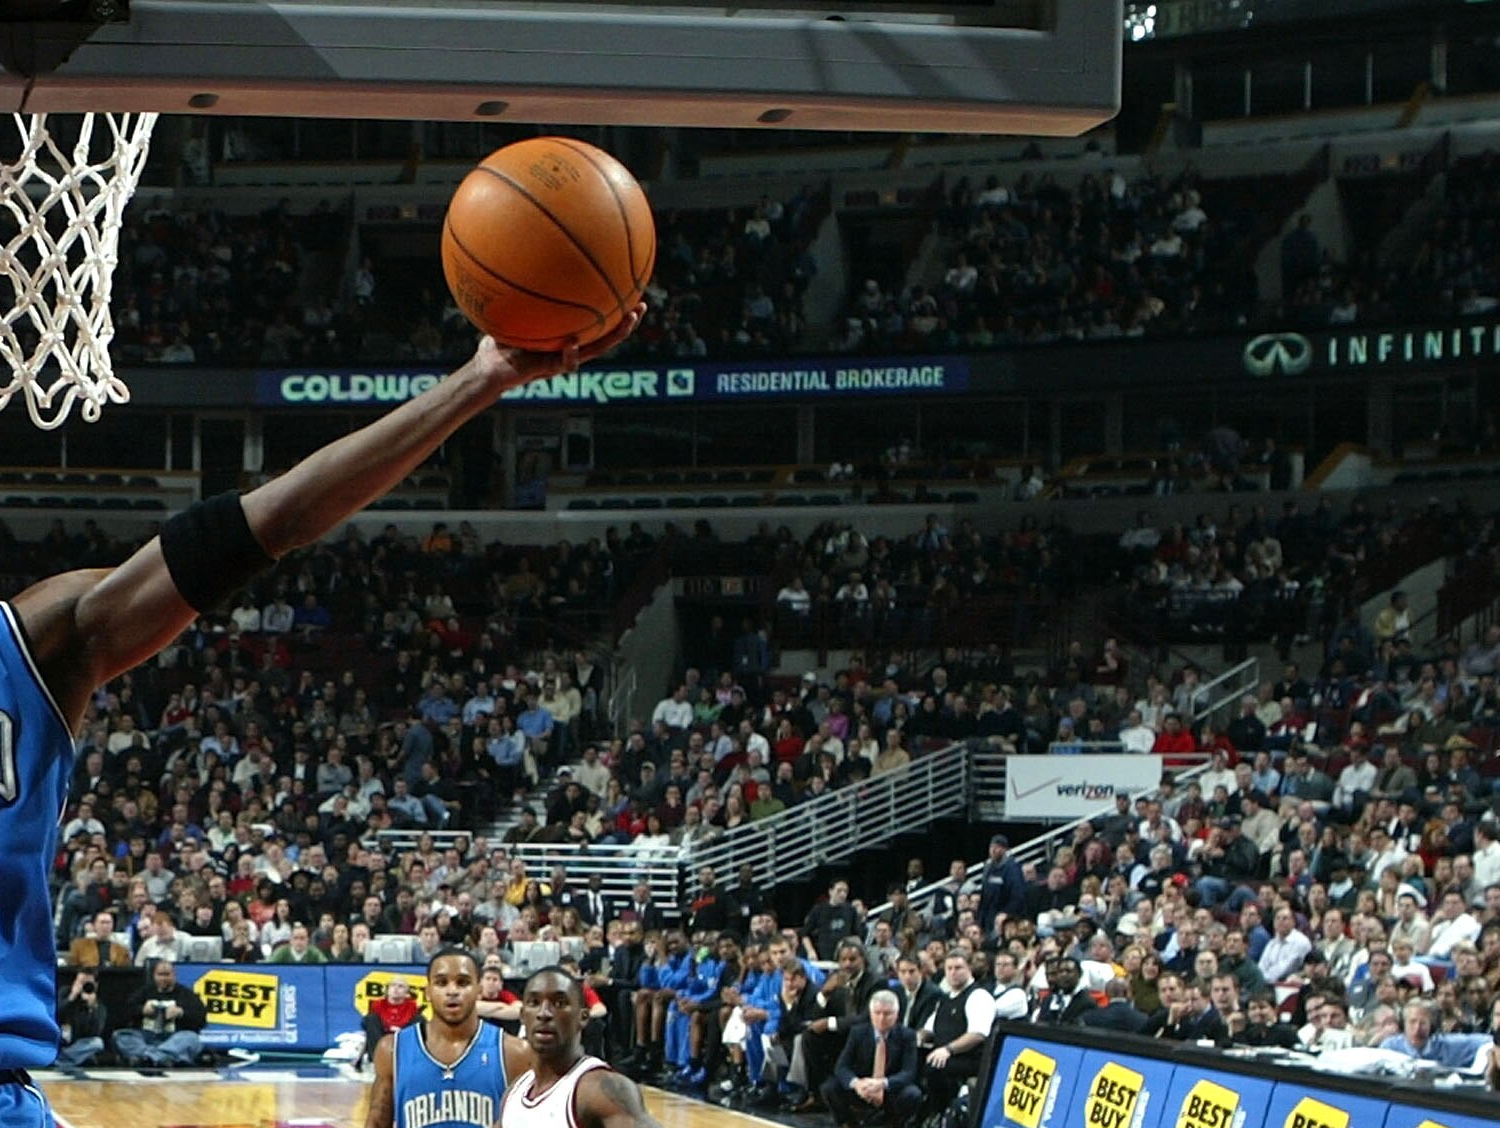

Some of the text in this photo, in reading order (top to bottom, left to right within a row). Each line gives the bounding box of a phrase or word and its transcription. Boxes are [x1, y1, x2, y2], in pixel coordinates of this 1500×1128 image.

[717, 367, 944, 393] RESIDENTIAL BROKERAGE
[1057, 779, 1113, 800] verizon
[205, 980, 275, 1001] BEST
[207, 997, 268, 1019] BUY
[1014, 1061, 1051, 1094] BEST
[1008, 1085, 1041, 1116] BUY
[1096, 1075, 1137, 1111] BEST
